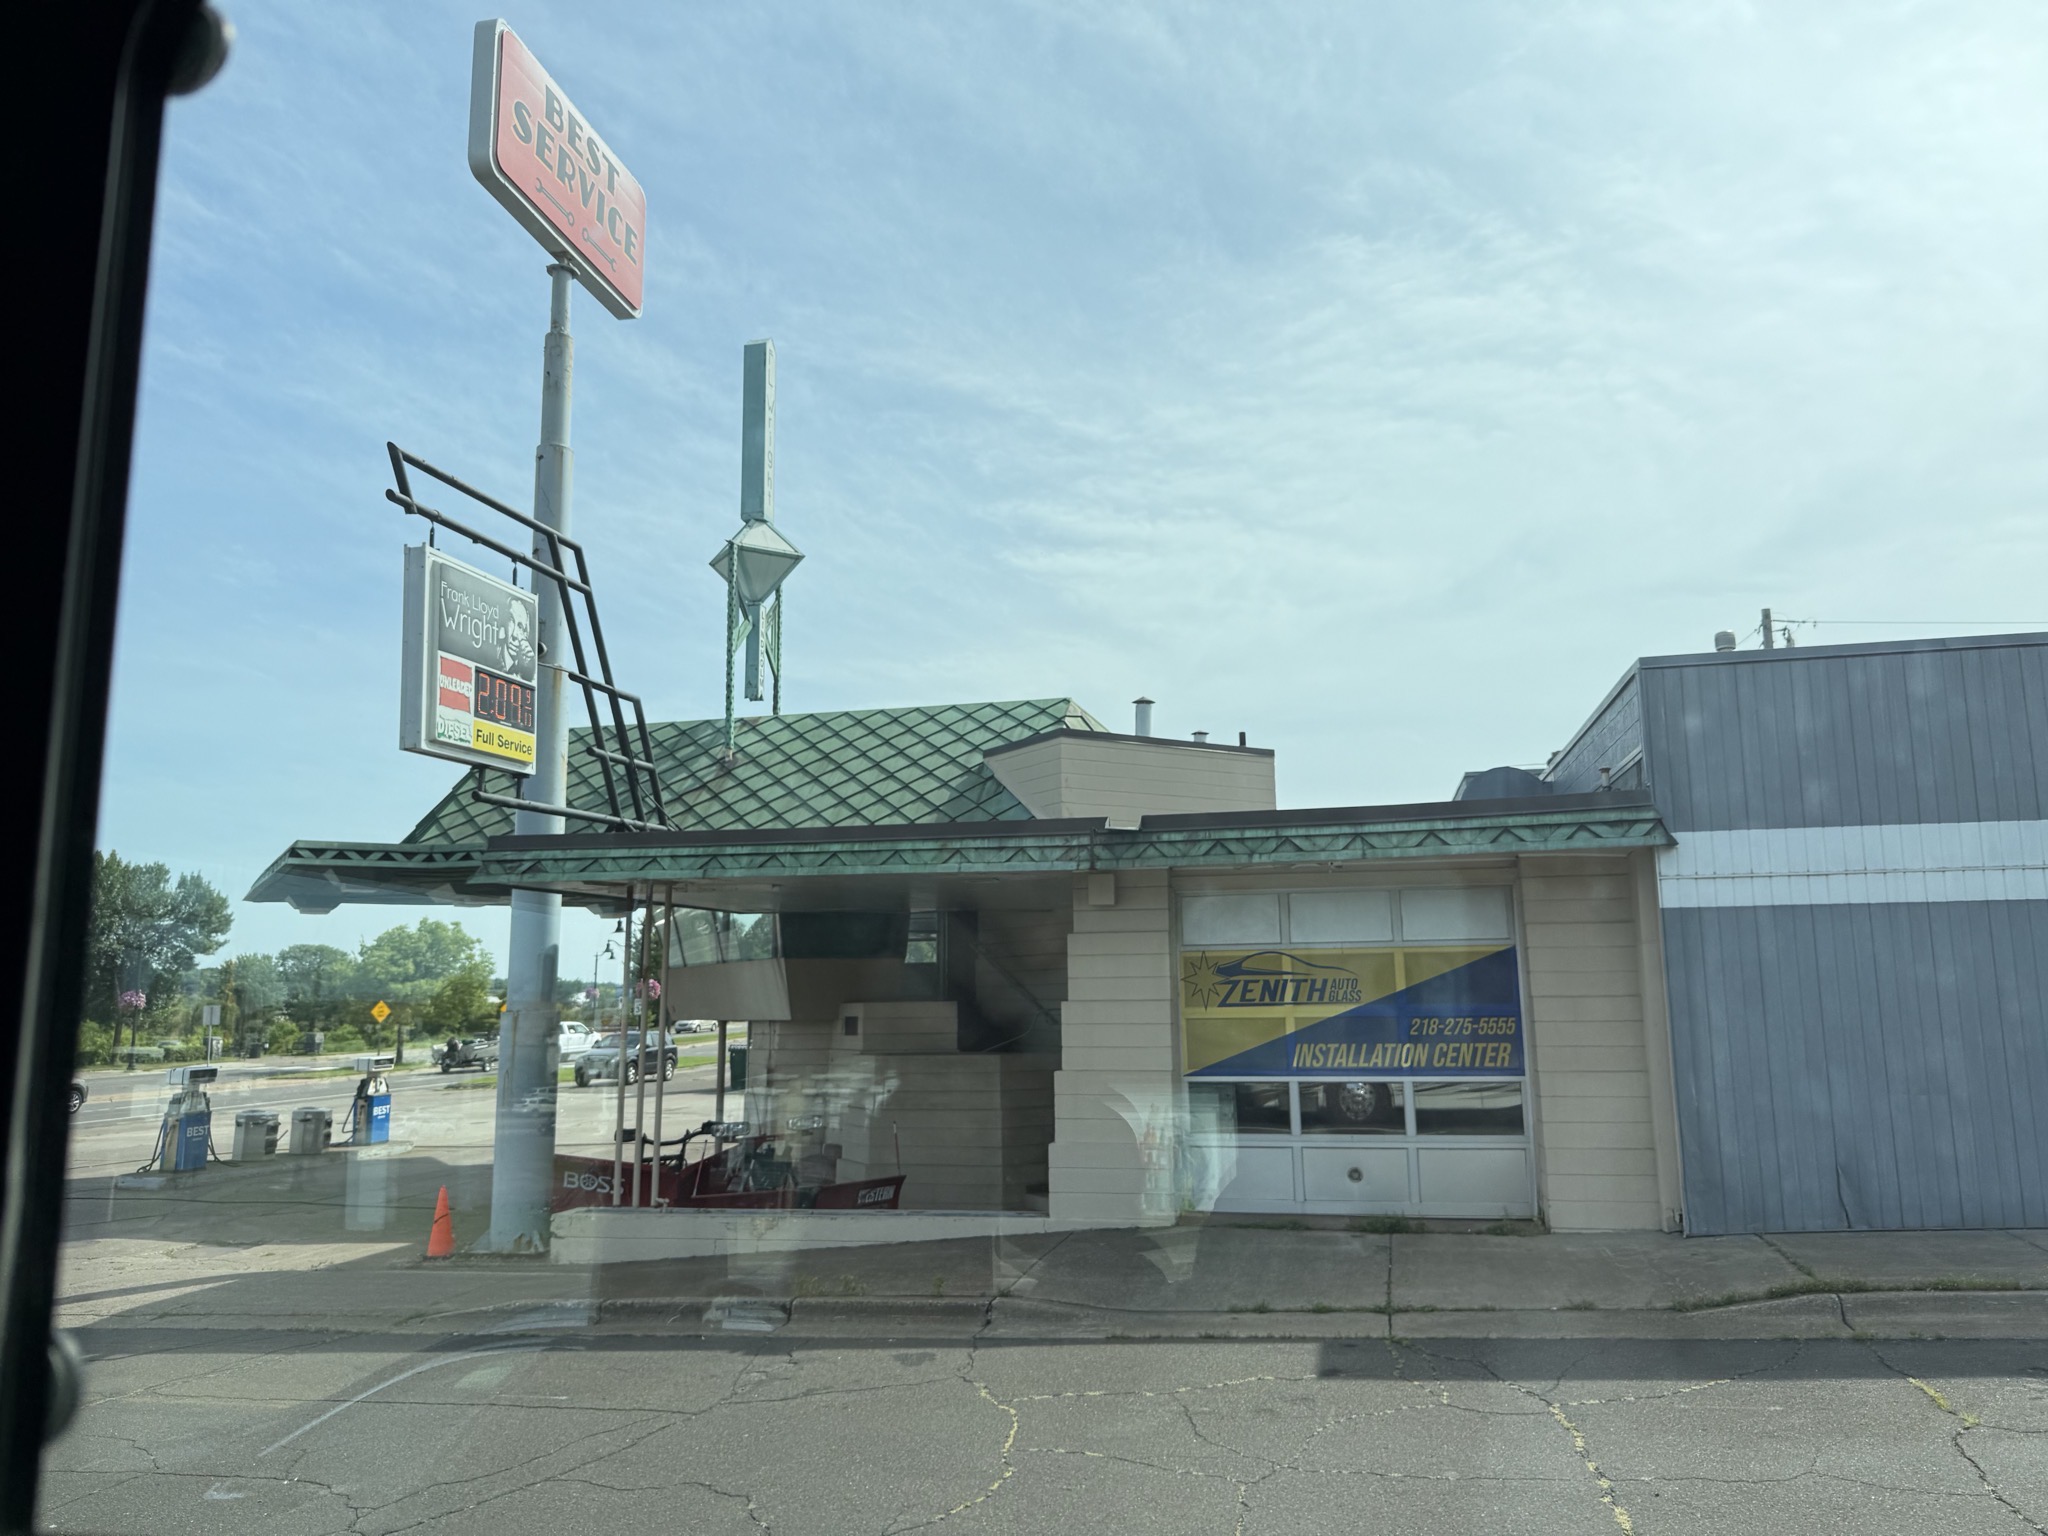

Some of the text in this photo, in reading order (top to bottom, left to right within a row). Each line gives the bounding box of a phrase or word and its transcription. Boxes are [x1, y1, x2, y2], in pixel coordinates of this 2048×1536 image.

[545, 84, 620, 197] BEST
[512, 100, 638, 266] SERVICE
[441, 580, 499, 620] Frank Lloyd
[441, 597, 499, 649] Wright
[476, 729, 533, 756] Full Service
[1217, 978, 1328, 1007] ZENITH
[1329, 990, 1362, 1002] GLASS
[1330, 978, 1358, 990] AUTO
[1410, 1017, 1516, 1036] 218-275-5555
[1292, 1042, 1512, 1068] INSTALLATION CENTER
[373, 1105, 391, 1116] BEST
[186, 1125, 210, 1137] BEST
